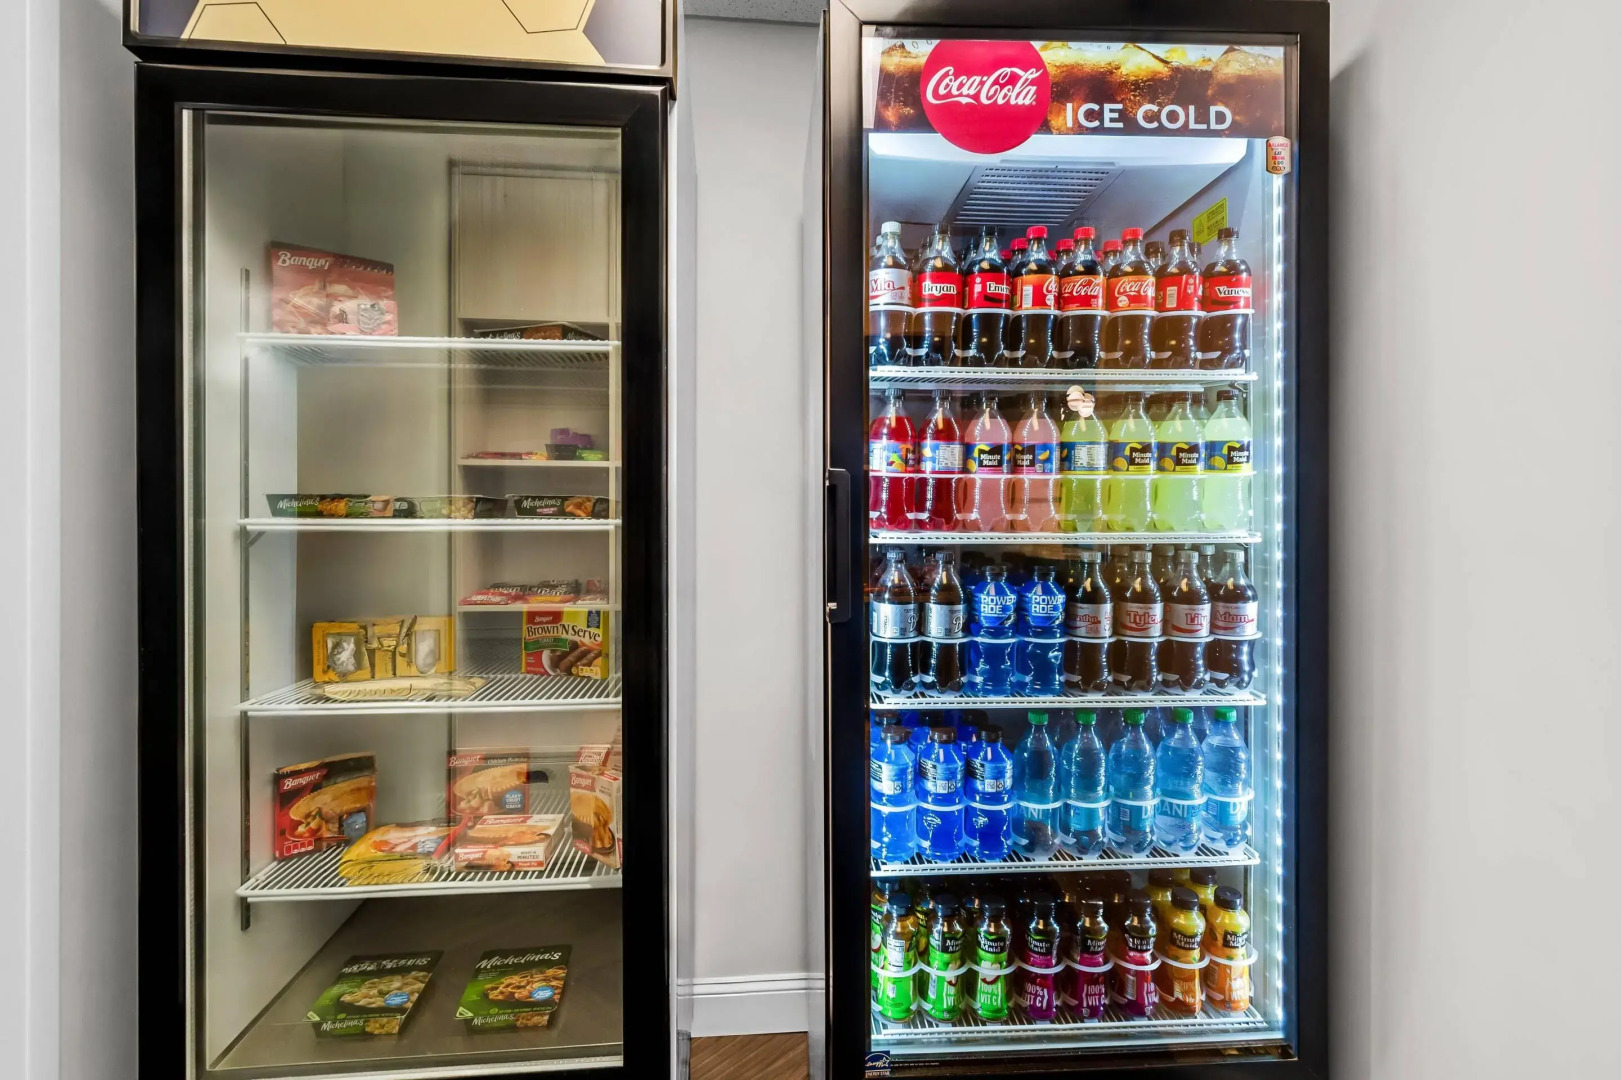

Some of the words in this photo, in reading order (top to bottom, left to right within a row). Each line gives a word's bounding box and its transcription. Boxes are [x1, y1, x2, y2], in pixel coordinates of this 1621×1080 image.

[926, 66, 1044, 106] Coca-Cola
[1066, 102, 1123, 128] ICE
[1137, 104, 1233, 130] COLD
[923, 283, 956, 295] Bryan
[522, 497, 561, 508] Michelina's
[981, 595, 1016, 604] POWER
[981, 605, 1002, 613] ADE
[1032, 604, 1054, 613] ADE
[1215, 611, 1248, 623] Adam
[571, 625, 601, 642] Serve
[980, 943, 1001, 953] Maid
[475, 952, 562, 969] Michelina's
[992, 995, 998, 1006] C
[1036, 996, 1042, 1007] C
[1087, 995, 1099, 1006] VIT
[471, 1013, 516, 1026] Michelina's
